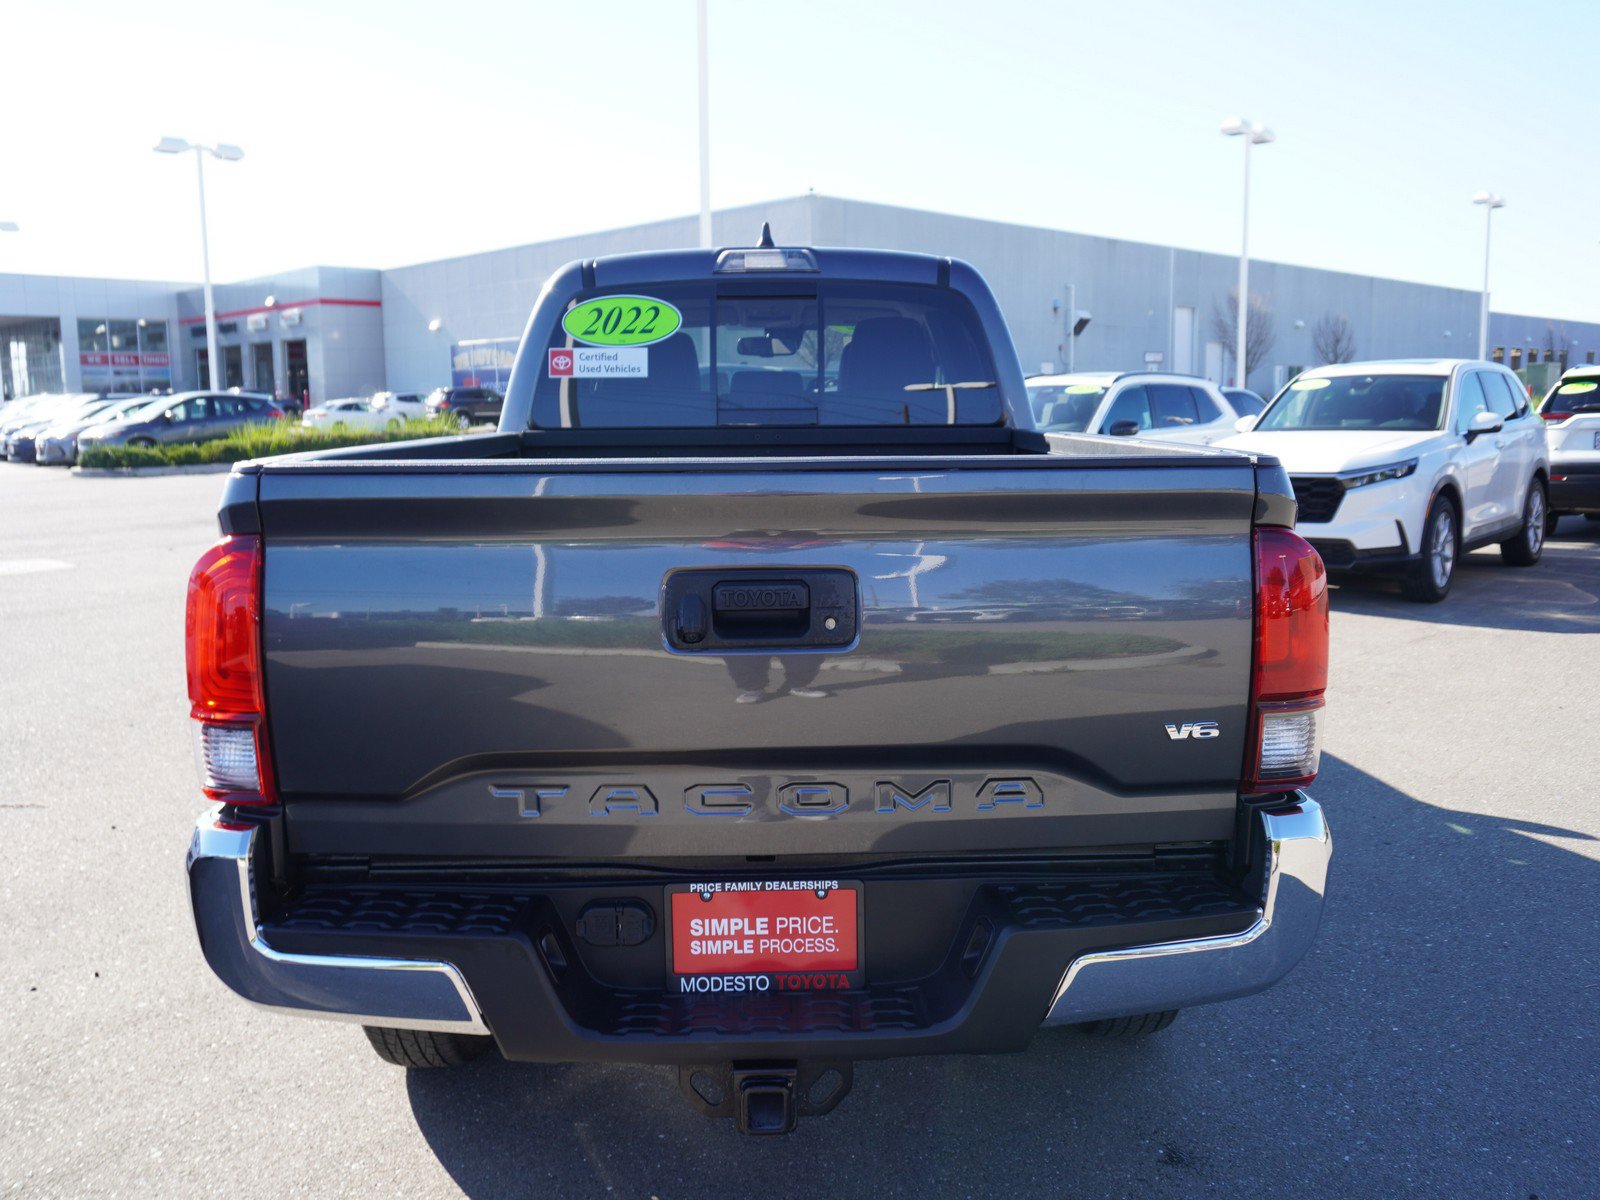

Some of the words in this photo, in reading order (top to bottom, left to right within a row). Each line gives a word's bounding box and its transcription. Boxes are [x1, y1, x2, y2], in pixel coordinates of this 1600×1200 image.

[581, 305, 660, 336] 2022
[579, 352, 618, 362] Certified
[579, 365, 602, 373] Used
[604, 364, 641, 373] Vehicles
[722, 589, 801, 608] TOYOTA
[1165, 721, 1220, 740] V6
[488, 777, 1045, 817] TACOMA
[690, 883, 722, 893] PRICE
[725, 881, 763, 892] FAMILY
[765, 880, 839, 891] DEALERSHIPS
[690, 917, 769, 937] SIMPLE
[776, 916, 839, 935] PRICE.
[690, 939, 755, 955] SIMPLE
[759, 938, 840, 954] PROCESS.
[680, 975, 770, 993] MODESTO
[775, 974, 850, 991] TOYOTA
